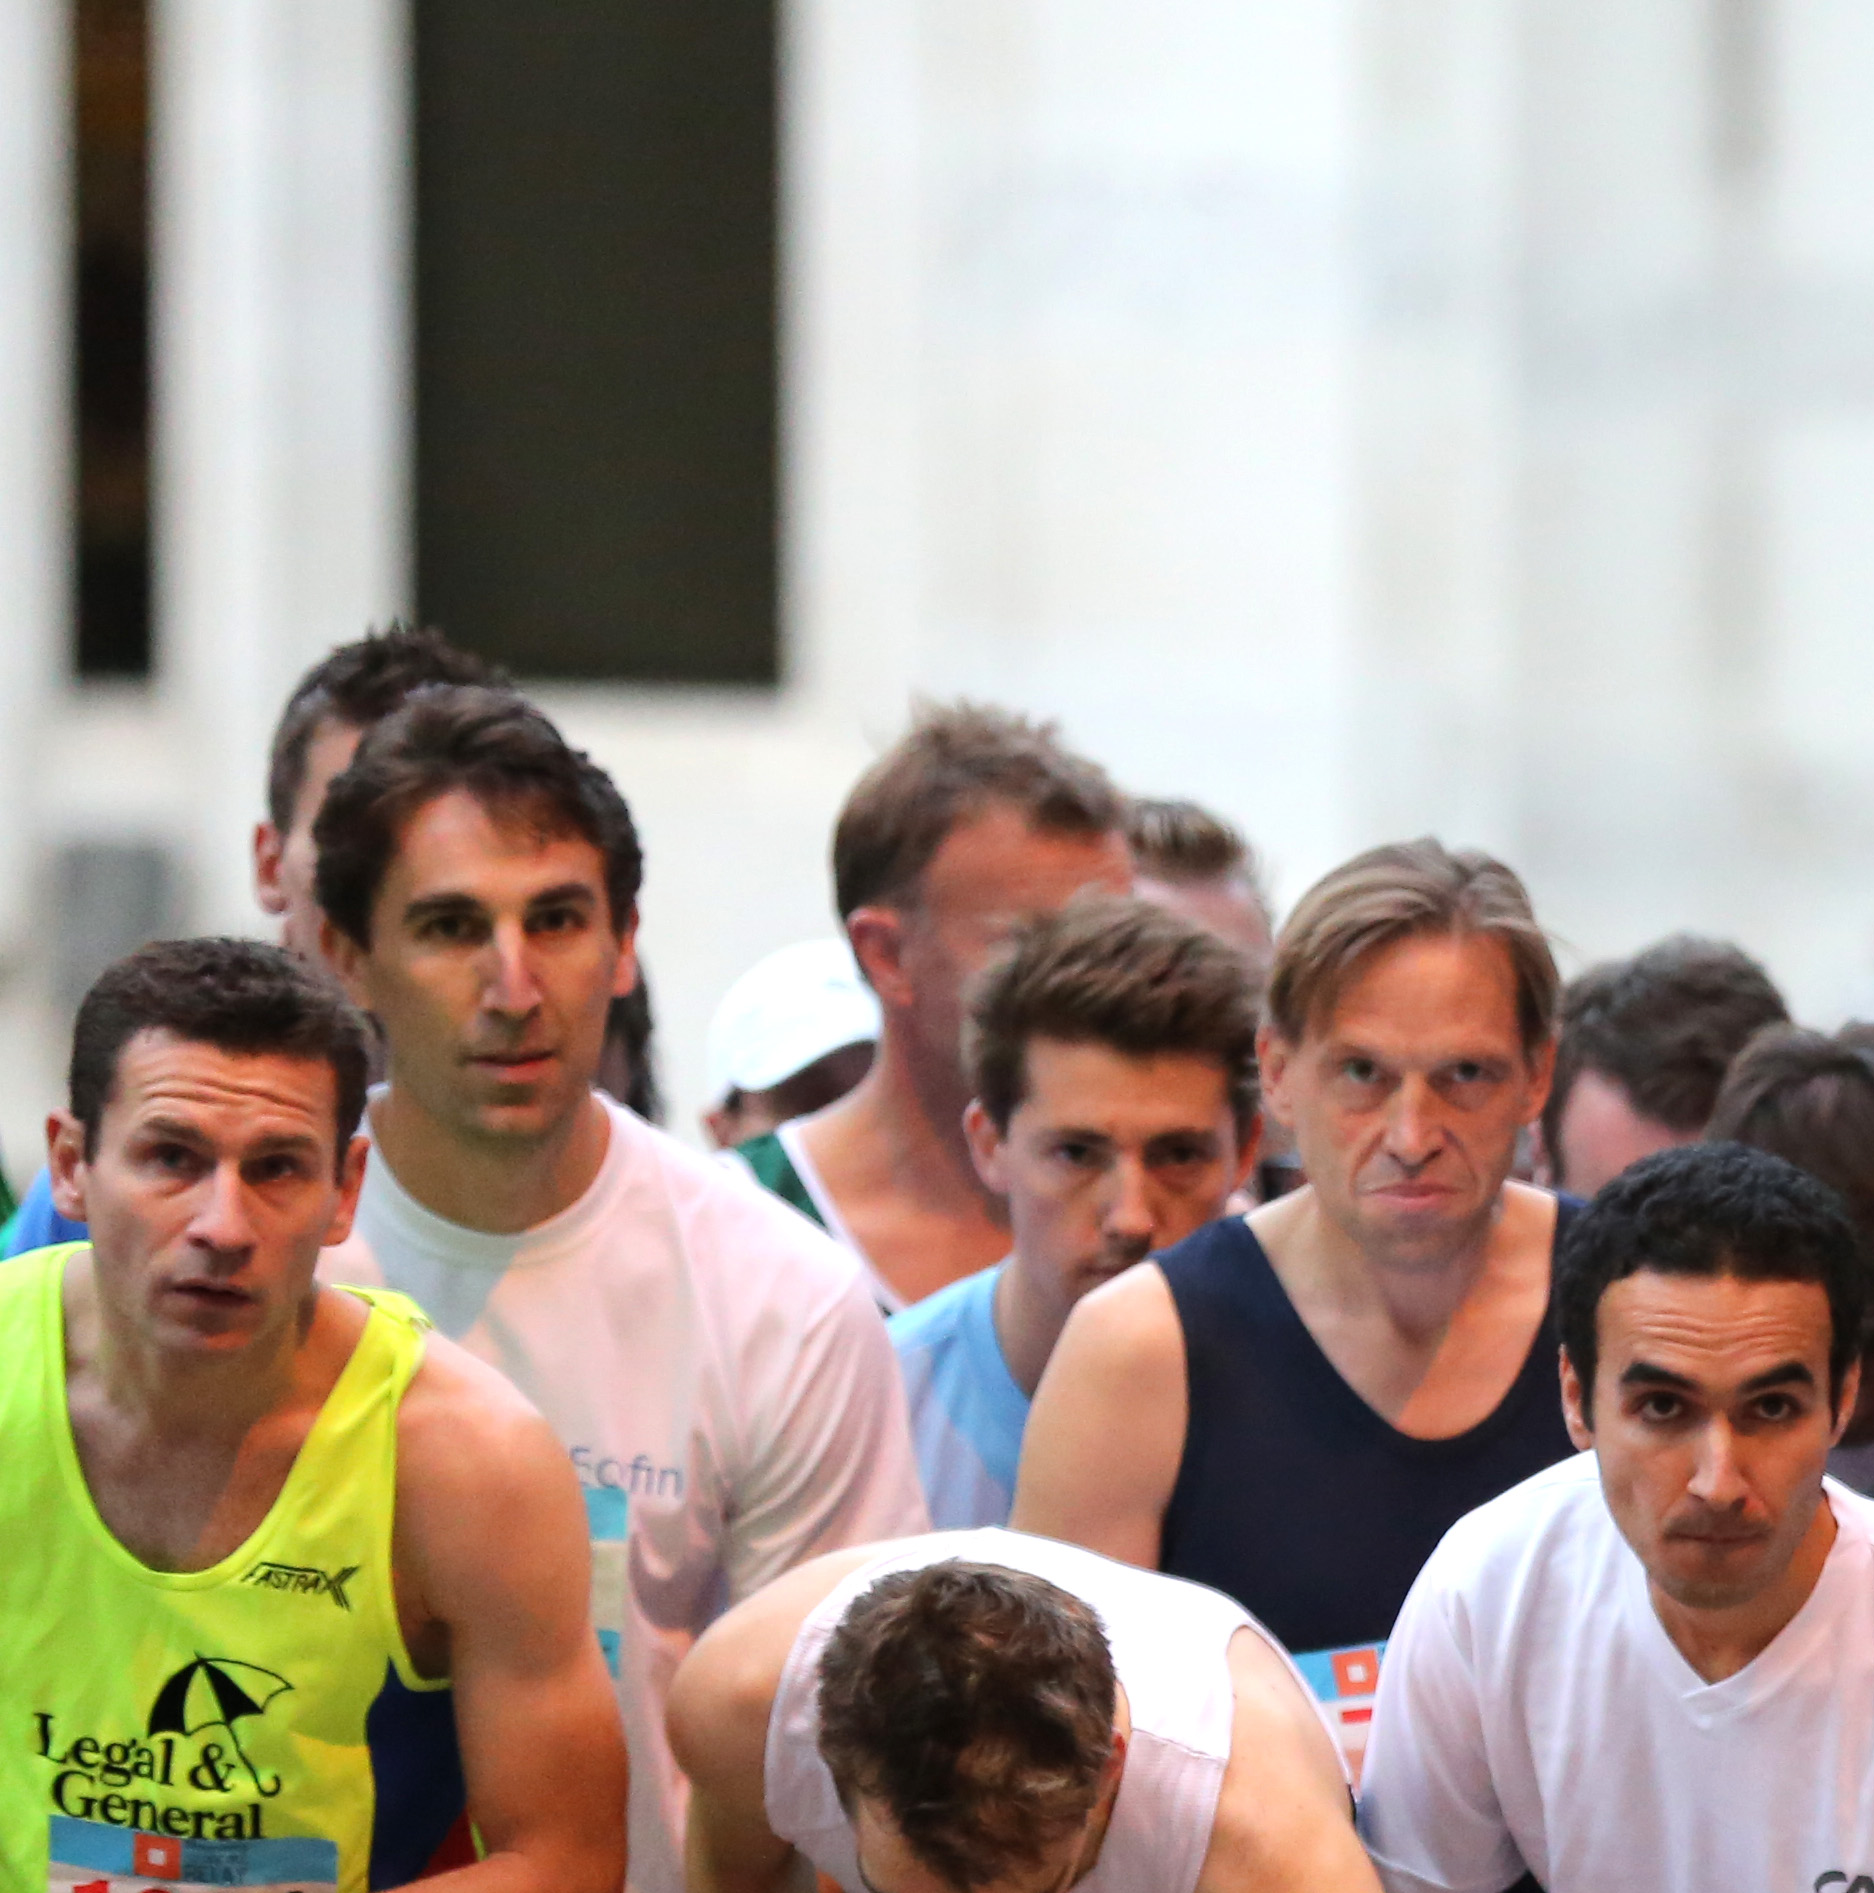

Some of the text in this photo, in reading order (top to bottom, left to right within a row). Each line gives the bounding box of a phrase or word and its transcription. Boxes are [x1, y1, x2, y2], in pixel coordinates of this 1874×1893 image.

[569, 1445, 685, 1498] Ecfin
[33, 1711, 236, 1793] Legal &
[51, 1768, 266, 1840] General
